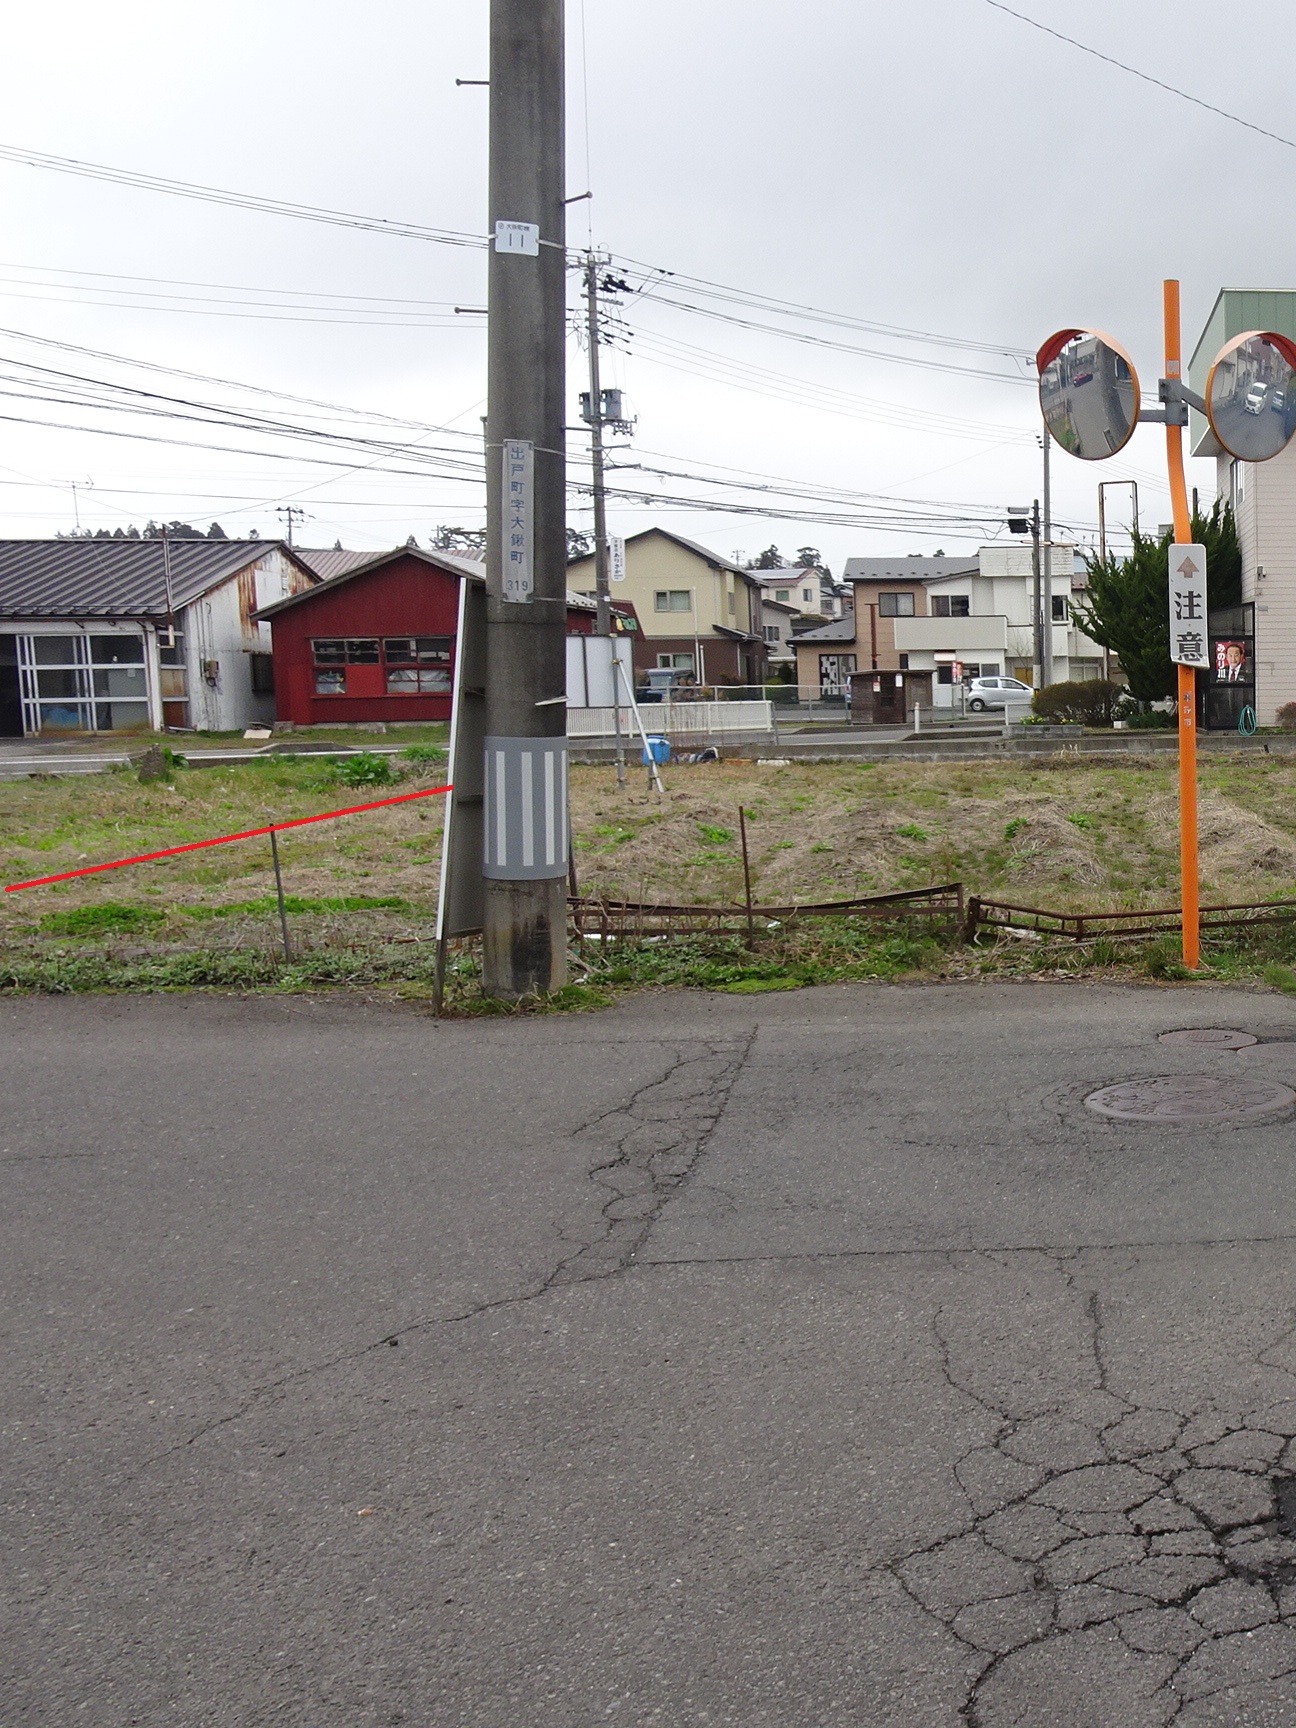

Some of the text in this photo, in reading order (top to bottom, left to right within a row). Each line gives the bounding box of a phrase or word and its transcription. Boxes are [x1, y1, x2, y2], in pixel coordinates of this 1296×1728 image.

[509, 233, 524, 247] 11
[510, 446, 525, 565] 出戸町字大鍬町
[506, 580, 528, 591] 319
[1174, 590, 1203, 661] 注意
[1216, 643, 1226, 679] みのり川
